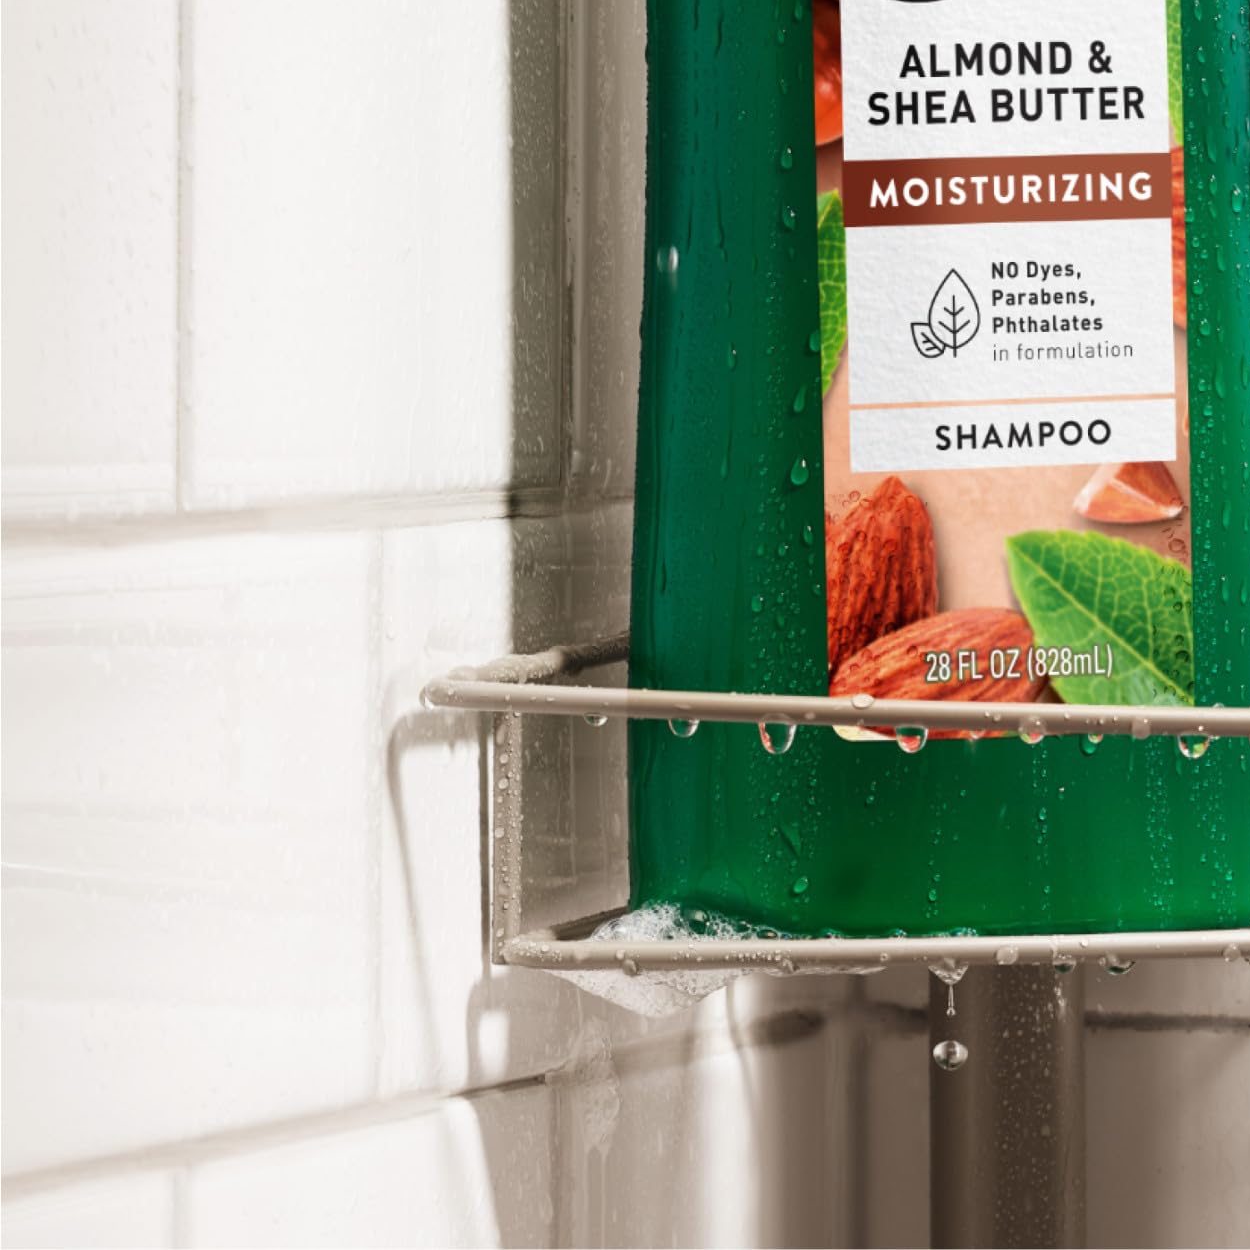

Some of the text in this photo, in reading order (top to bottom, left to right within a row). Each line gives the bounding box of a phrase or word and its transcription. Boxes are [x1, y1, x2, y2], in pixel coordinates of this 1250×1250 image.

[900, 41, 1112, 78] ALMOND &
[868, 86, 1145, 125] SHEA BUTTER
[870, 172, 1152, 208] MOISTURIZING
[992, 261, 1082, 281] NO Dyes,
[992, 288, 1095, 306] Parabens,
[992, 316, 1103, 333] Phthalates
[993, 342, 1133, 361] in formulation
[935, 419, 1111, 450] SHAMPOO
[926, 645, 1113, 682] 28 FL OZ (828mL)
